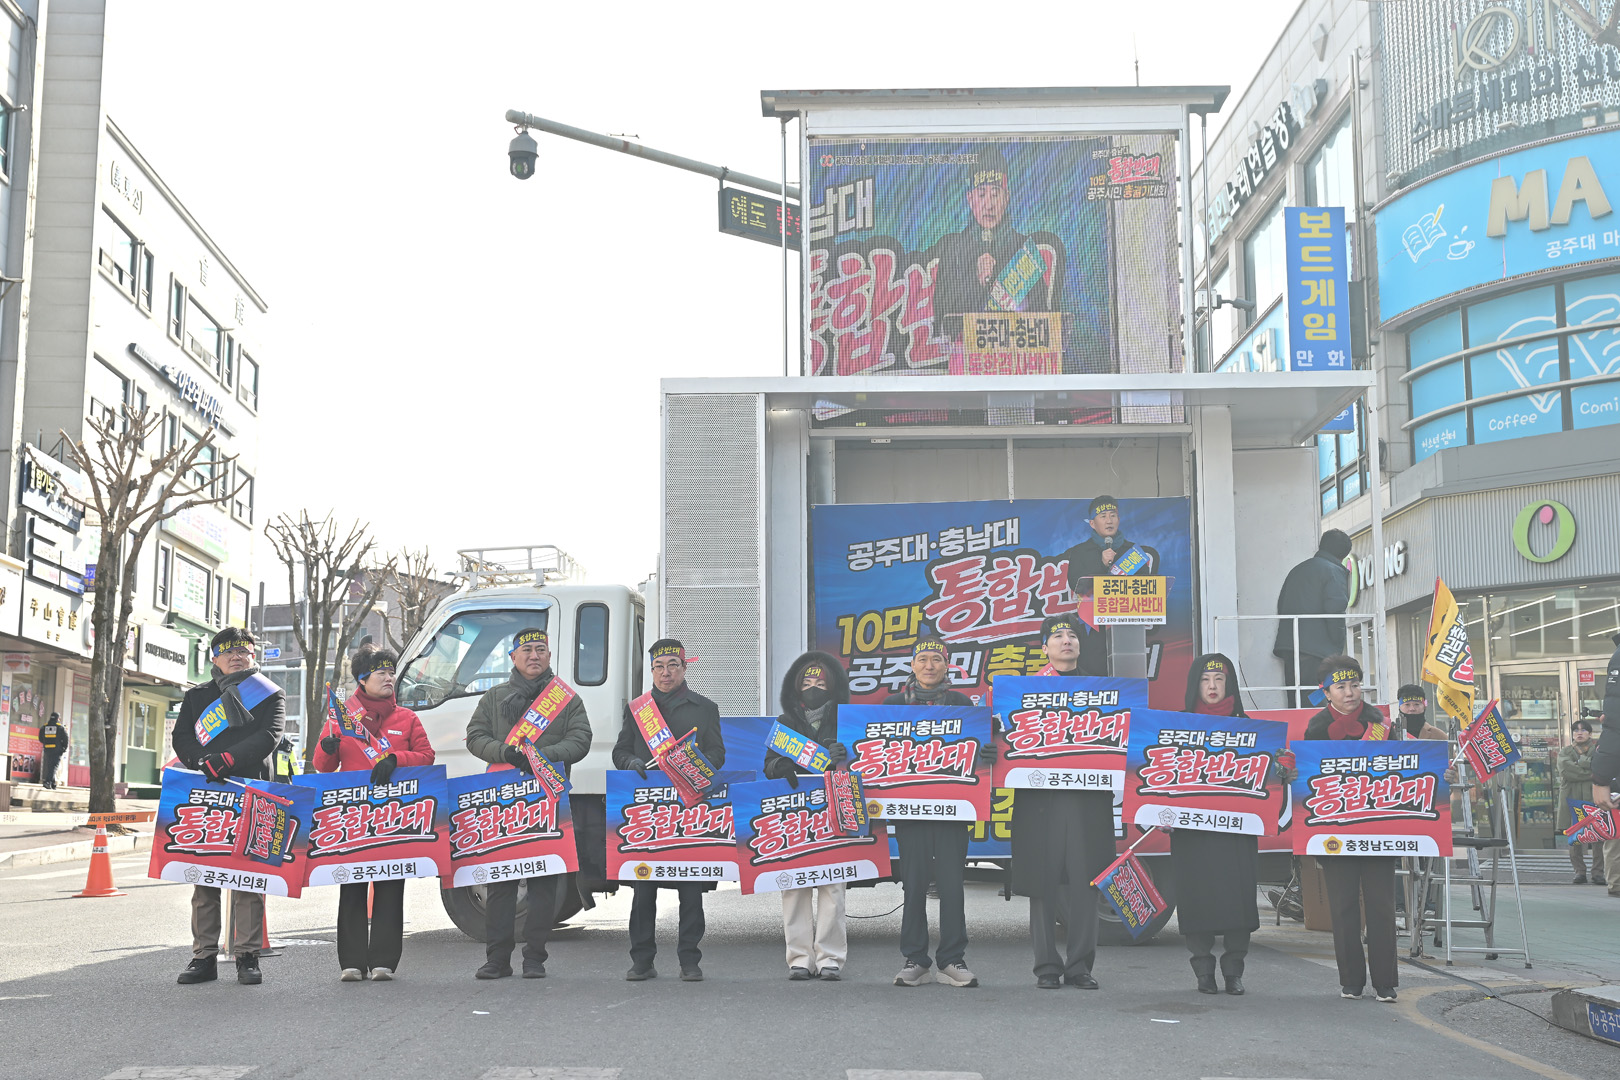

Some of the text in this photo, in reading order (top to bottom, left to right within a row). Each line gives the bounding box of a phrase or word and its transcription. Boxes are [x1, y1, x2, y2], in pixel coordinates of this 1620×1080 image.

[1487, 155, 1613, 238] MA
[1546, 233, 1596, 259] 공주대
[1299, 211, 1337, 341] 보드게임
[1488, 413, 1538, 431] Coffee
[848, 518, 1019, 571] 공주대·충남대
[1358, 541, 1406, 590] YONG
[1097, 597, 1163, 613] 통합결사반대
[838, 605, 924, 655] 10만
[915, 641, 943, 654] 통합반대
[848, 650, 982, 692] 공주민
[1022, 690, 1119, 708] 공주대·충남대
[523, 708, 550, 730] 결사
[866, 718, 961, 738] 공주대·충남대
[1006, 709, 1131, 749] 통합반대
[1158, 729, 1257, 748] 공주대·충남대
[850, 739, 978, 779] 통합반대
[1140, 746, 1270, 791] 통합반대
[1320, 754, 1419, 774] 공주대·충남대
[1048, 772, 1113, 787] 공주시의회
[322, 780, 418, 806] 공주대·충남대
[458, 779, 540, 809] 공주대·충남대
[761, 788, 828, 813] 공주대·충
[1307, 775, 1435, 816] 통합반대
[885, 802, 958, 816] 충청남도의회
[1178, 811, 1243, 830] 공주시의회
[249, 796, 278, 860] 통합반대
[309, 799, 435, 849] 통합반대
[450, 797, 557, 850] 통합반대
[620, 803, 736, 844] 통합반대
[1345, 839, 1419, 852] 충청남도의회
[203, 870, 268, 891] 공주시의회
[352, 862, 416, 880] 공주시의회
[489, 860, 547, 880] 공주시의회
[654, 866, 723, 877] 충청남도의회
[794, 865, 858, 885] 공주시의회
[1112, 865, 1153, 926] 통합반대
